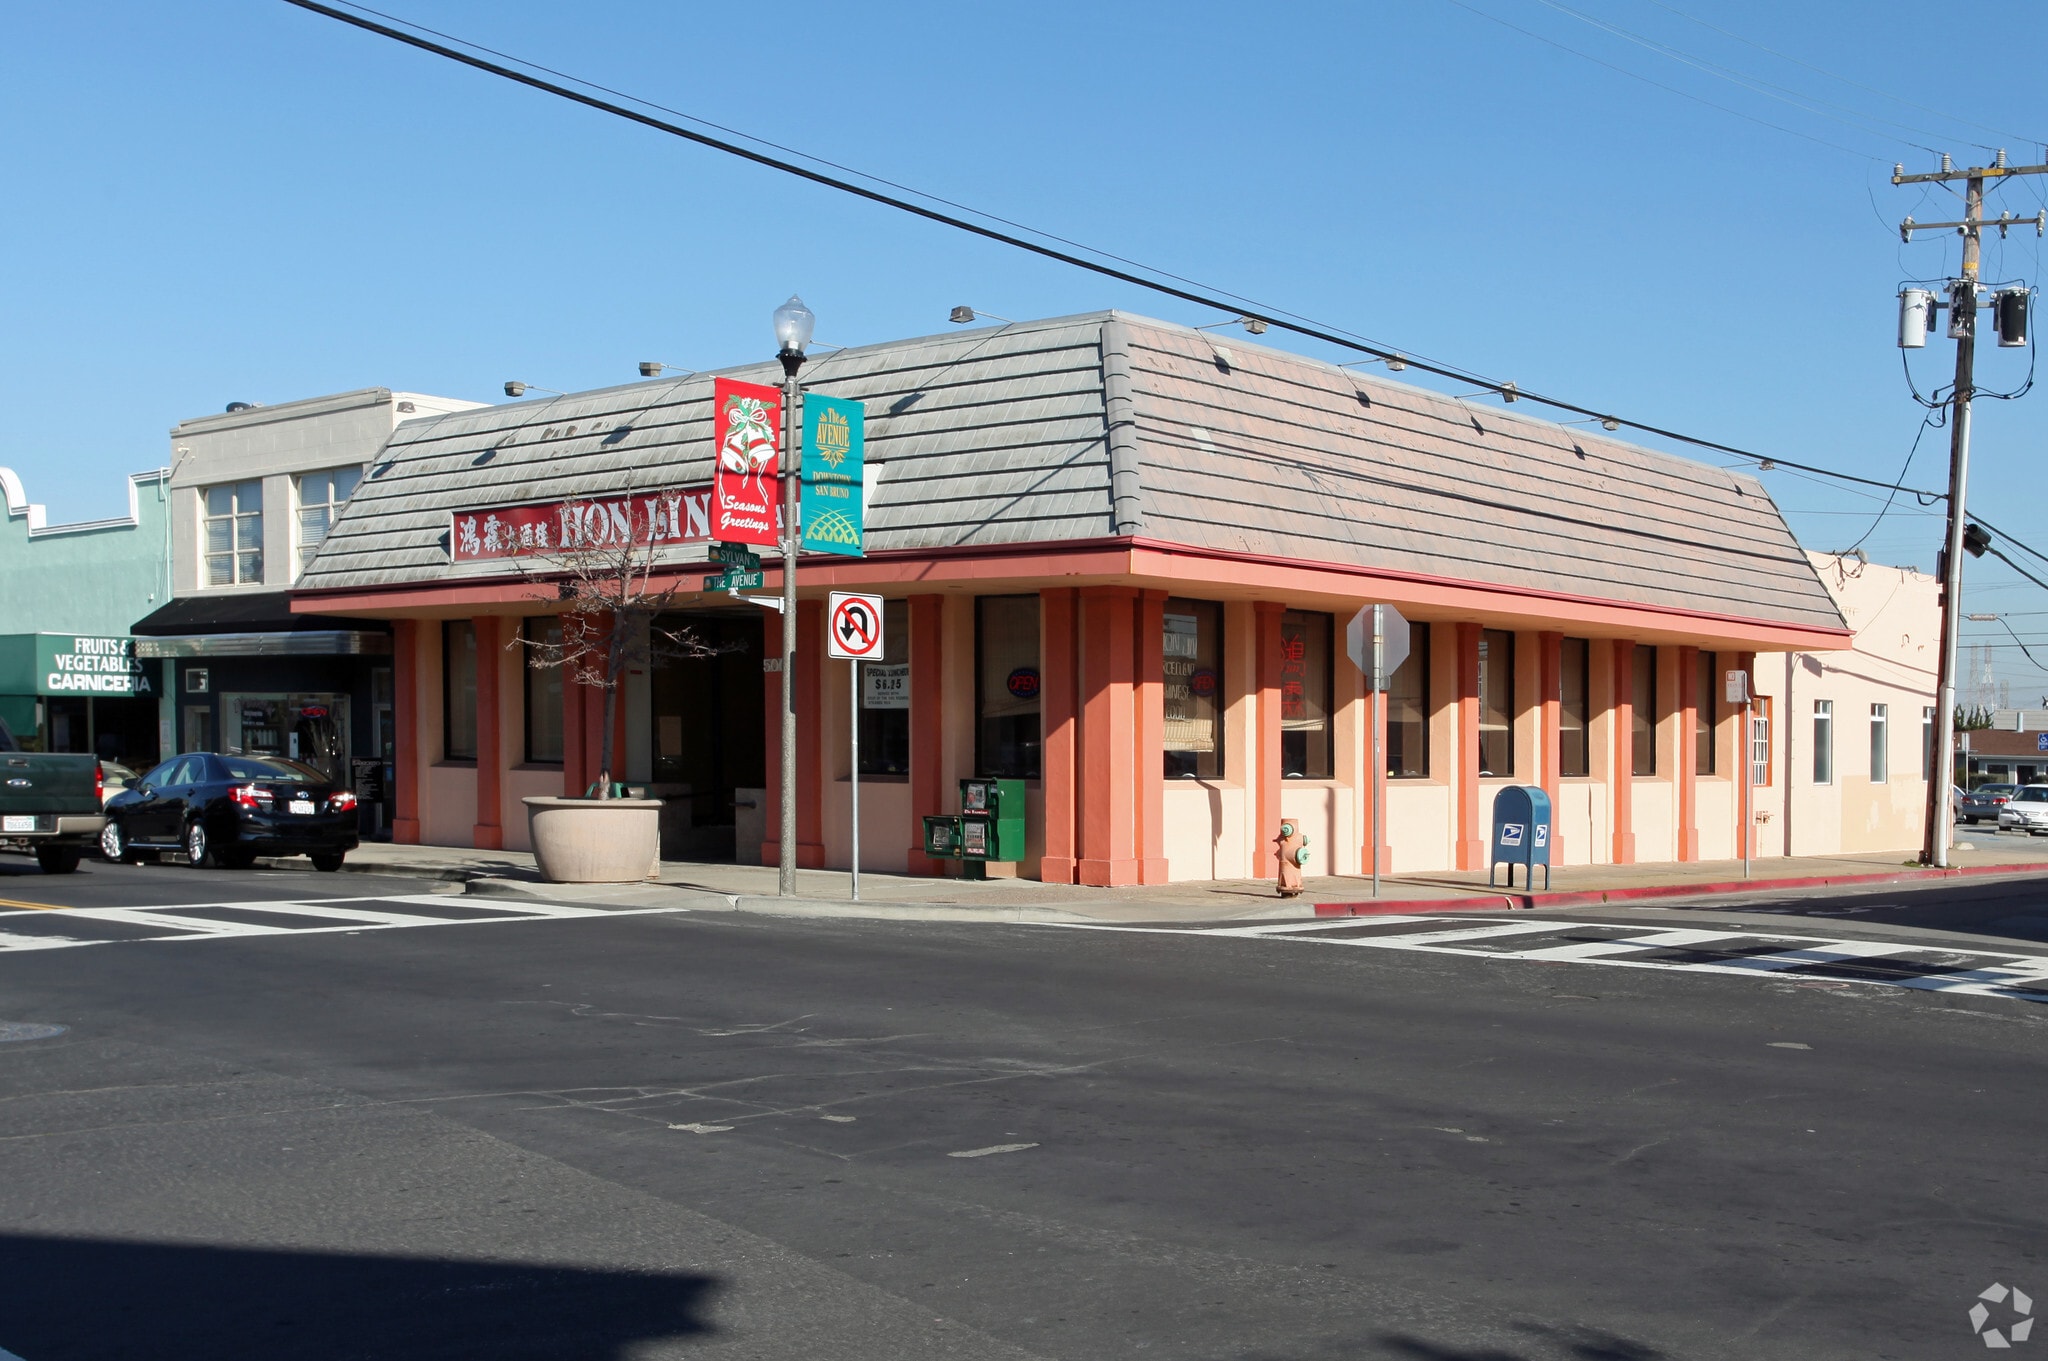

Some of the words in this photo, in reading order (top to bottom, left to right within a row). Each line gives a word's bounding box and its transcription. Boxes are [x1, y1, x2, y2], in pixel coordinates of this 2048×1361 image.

[827, 407, 839, 424] The
[816, 423, 850, 447] AVENUE
[813, 471, 851, 484] DOWNTOWN
[815, 484, 829, 497] SAN
[830, 486, 850, 499] BRUNO
[724, 494, 767, 514] Seasons
[559, 500, 632, 548] HON
[644, 493, 712, 541] LIN
[720, 511, 769, 534] Greetings
[720, 550, 750, 566] SYLVAN
[714, 576, 726, 588] THE
[731, 573, 758, 587] AVENUE
[75, 638, 118, 655] FRUITS
[119, 639, 130, 656] &
[1163, 632, 1180, 652] ON
[55, 654, 143, 673] VEGETABLES
[48, 672, 151, 692] CARNICERIA
[875, 678, 902, 690] $6.25
[1009, 675, 1039, 691] OPEN
[301, 707, 327, 716] OPEN
